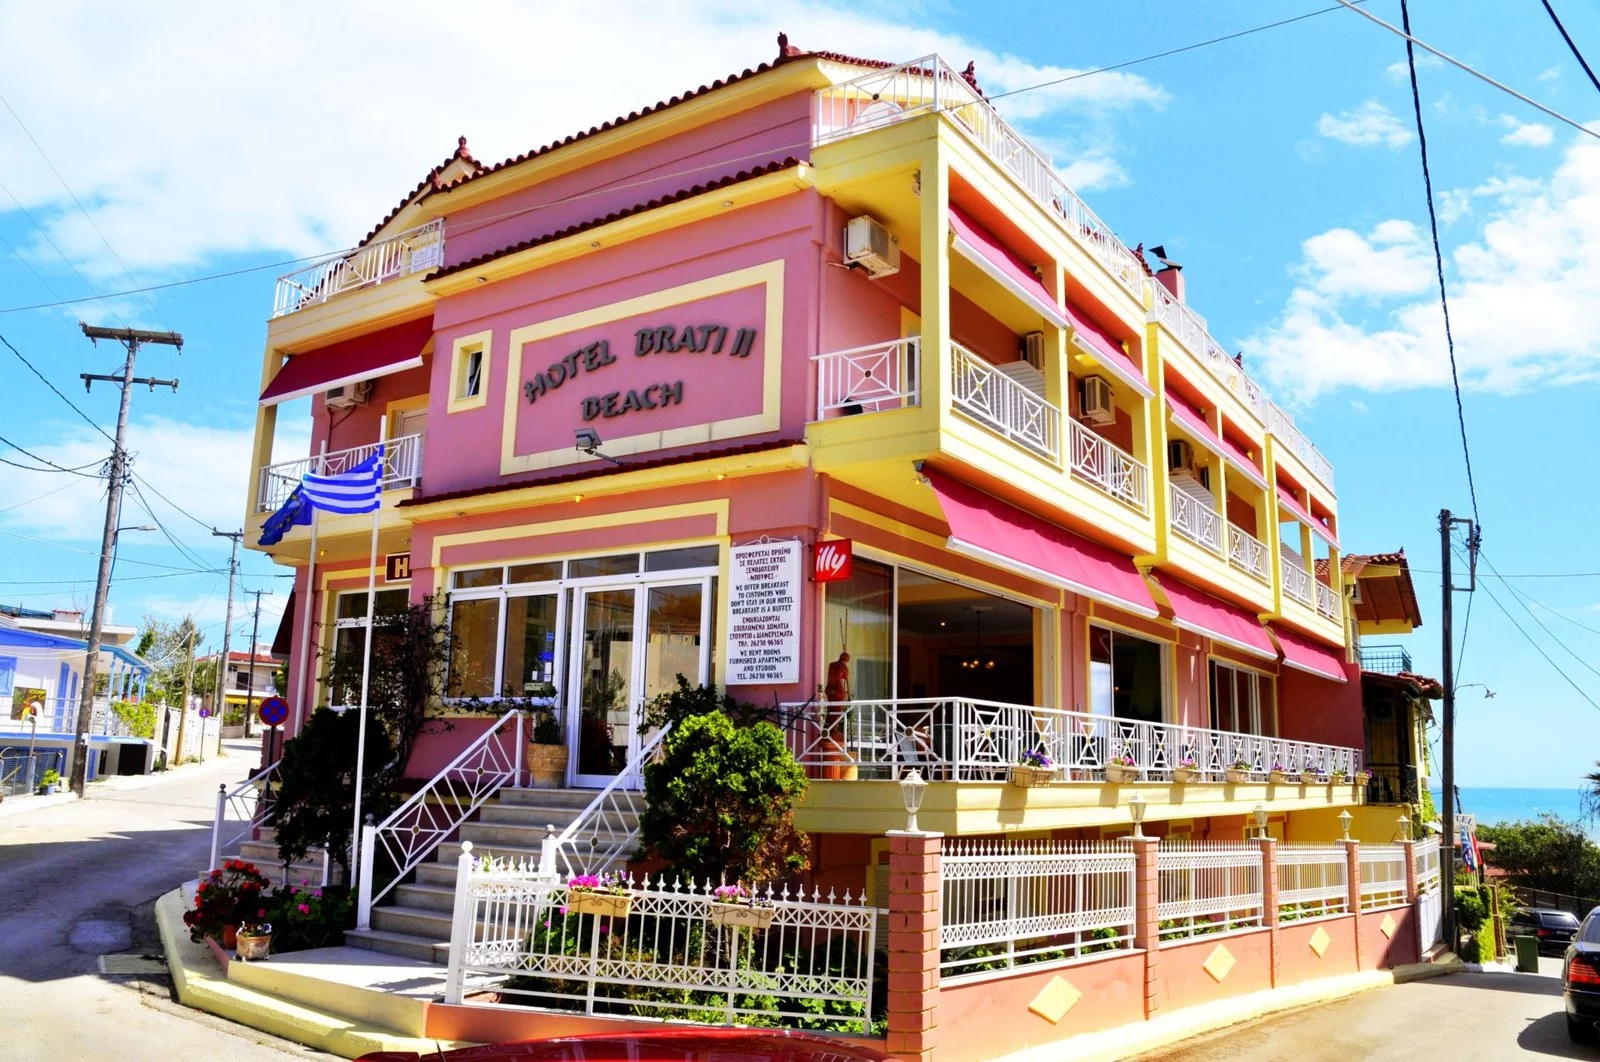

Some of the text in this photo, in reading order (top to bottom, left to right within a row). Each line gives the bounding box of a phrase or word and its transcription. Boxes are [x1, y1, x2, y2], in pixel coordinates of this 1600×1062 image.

[524, 339, 617, 404] HOTEL
[634, 324, 728, 357] BRATI
[580, 380, 684, 421] BEACH
[735, 550, 770, 560] ΠΡΟΣΦΕΡΕΤΑΙ
[747, 558, 769, 566] ΠΕΛΑΤΕΣ
[816, 545, 847, 577] illy
[394, 557, 409, 578] H
[760, 582, 789, 590] BREAKFAST
[745, 590, 774, 598] CUSTOMERS
[766, 622, 790, 630] ΔΩΜΑΤΙΑ
[756, 630, 794, 638] ΔΙΑΜΕΡΙΣΜΑΤΑ
